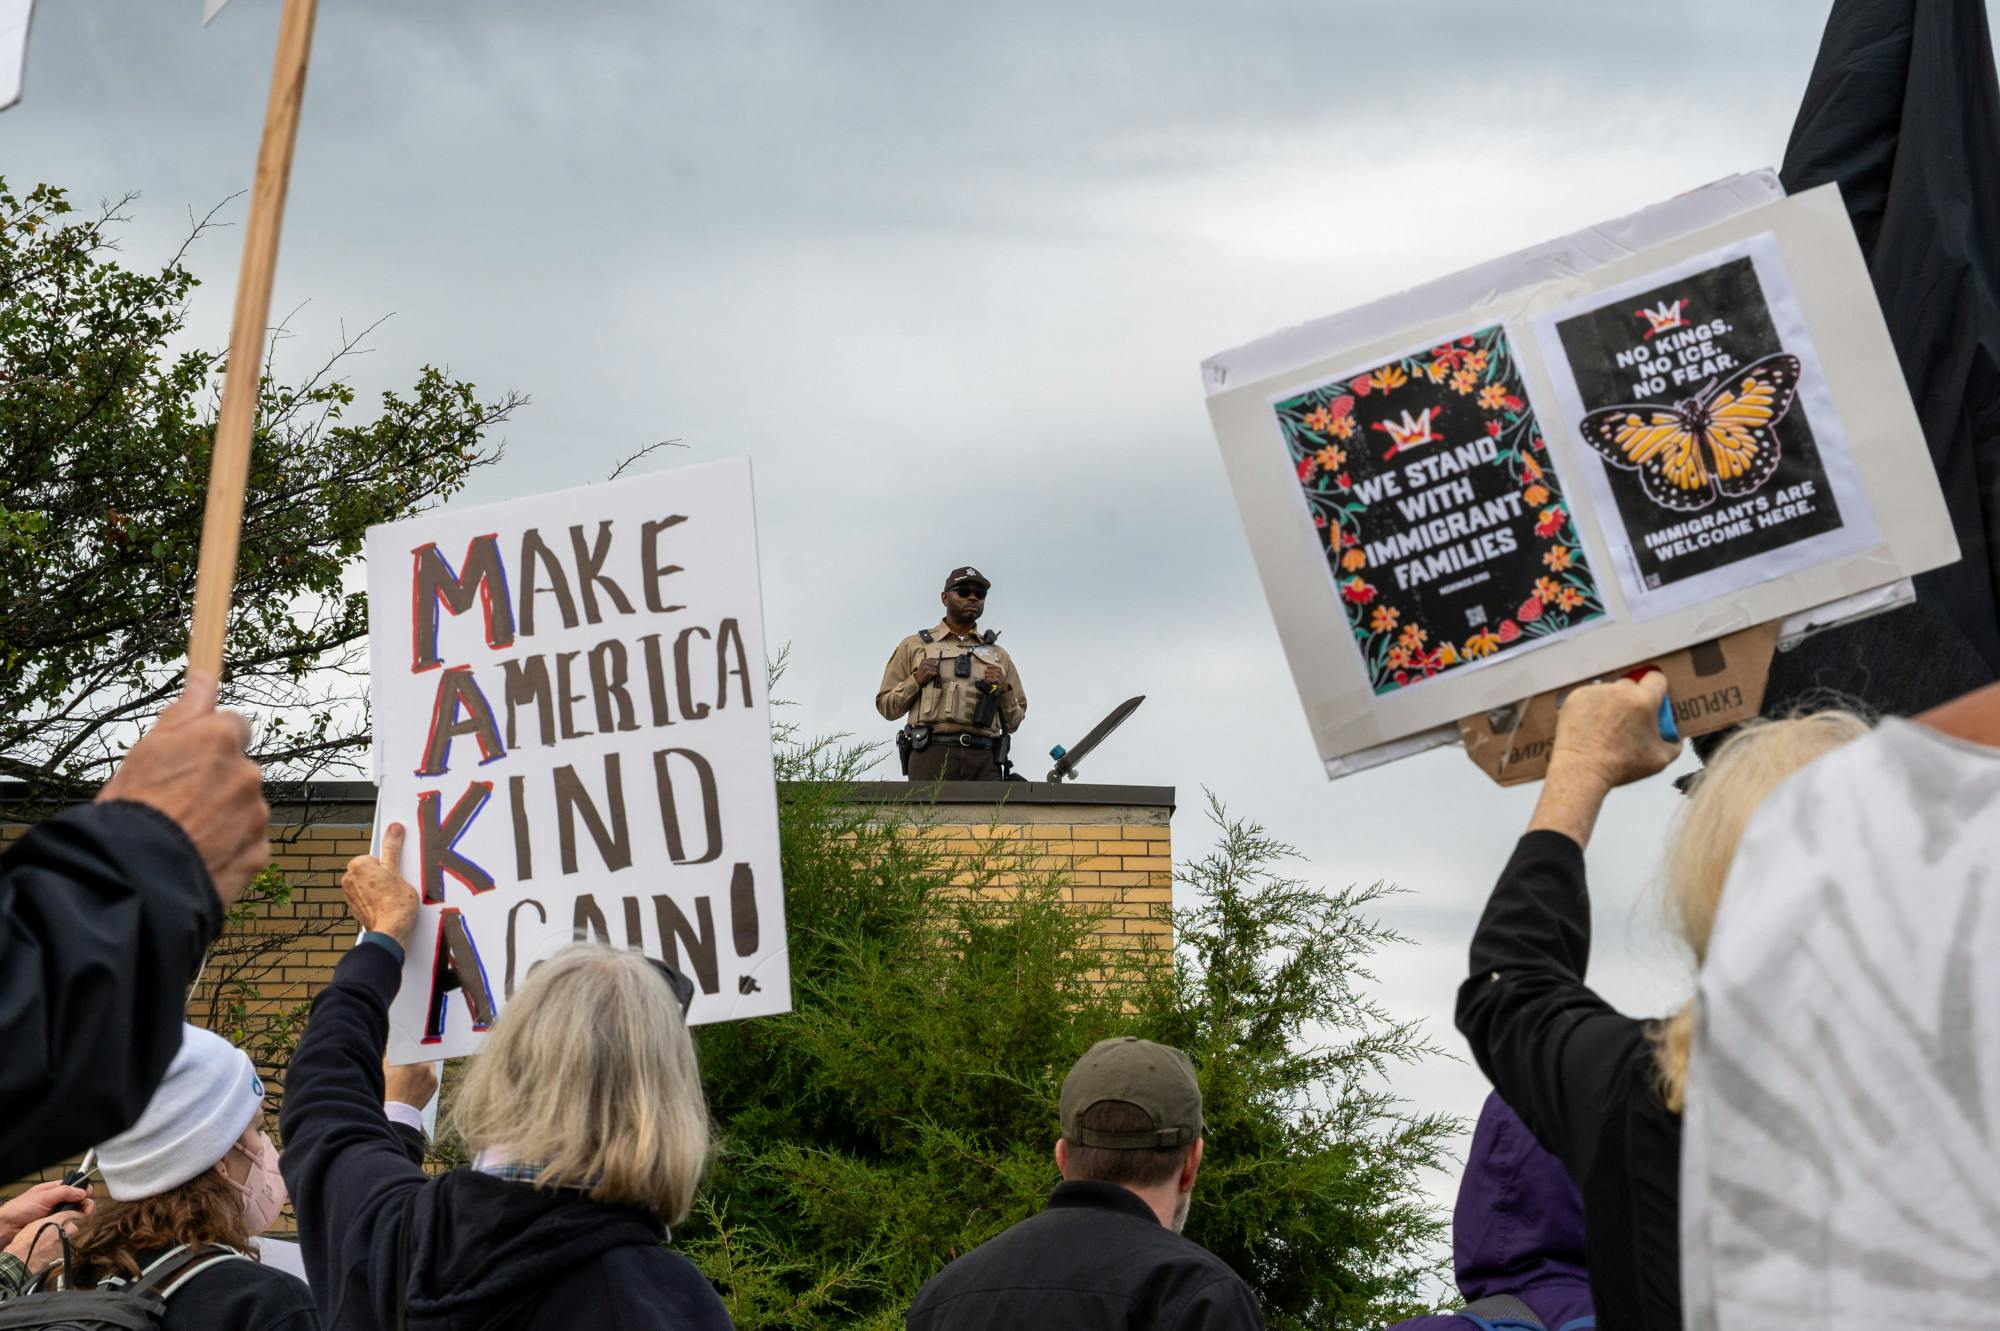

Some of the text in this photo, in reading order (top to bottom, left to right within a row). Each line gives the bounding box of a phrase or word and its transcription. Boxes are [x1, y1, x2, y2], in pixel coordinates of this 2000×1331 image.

[1615, 319, 1733, 368] NO KINGS.
[1638, 341, 1722, 379] NO ICE.
[1632, 354, 1739, 400] NO FEAR.
[1352, 436, 1498, 505] WE STAND
[1396, 477, 1475, 523] WITH
[1364, 490, 1522, 568] IMMIGRANT
[1644, 480, 1816, 549] IMMIGRANTS ARE
[1655, 500, 1816, 562] WELCOME HERE.
[1394, 527, 1517, 591] FAMILIES
[410, 514, 688, 674] MAKE
[414, 618, 753, 777] AMERICA
[1671, 686, 1743, 723] EXPLOR
[416, 748, 723, 905] KIND
